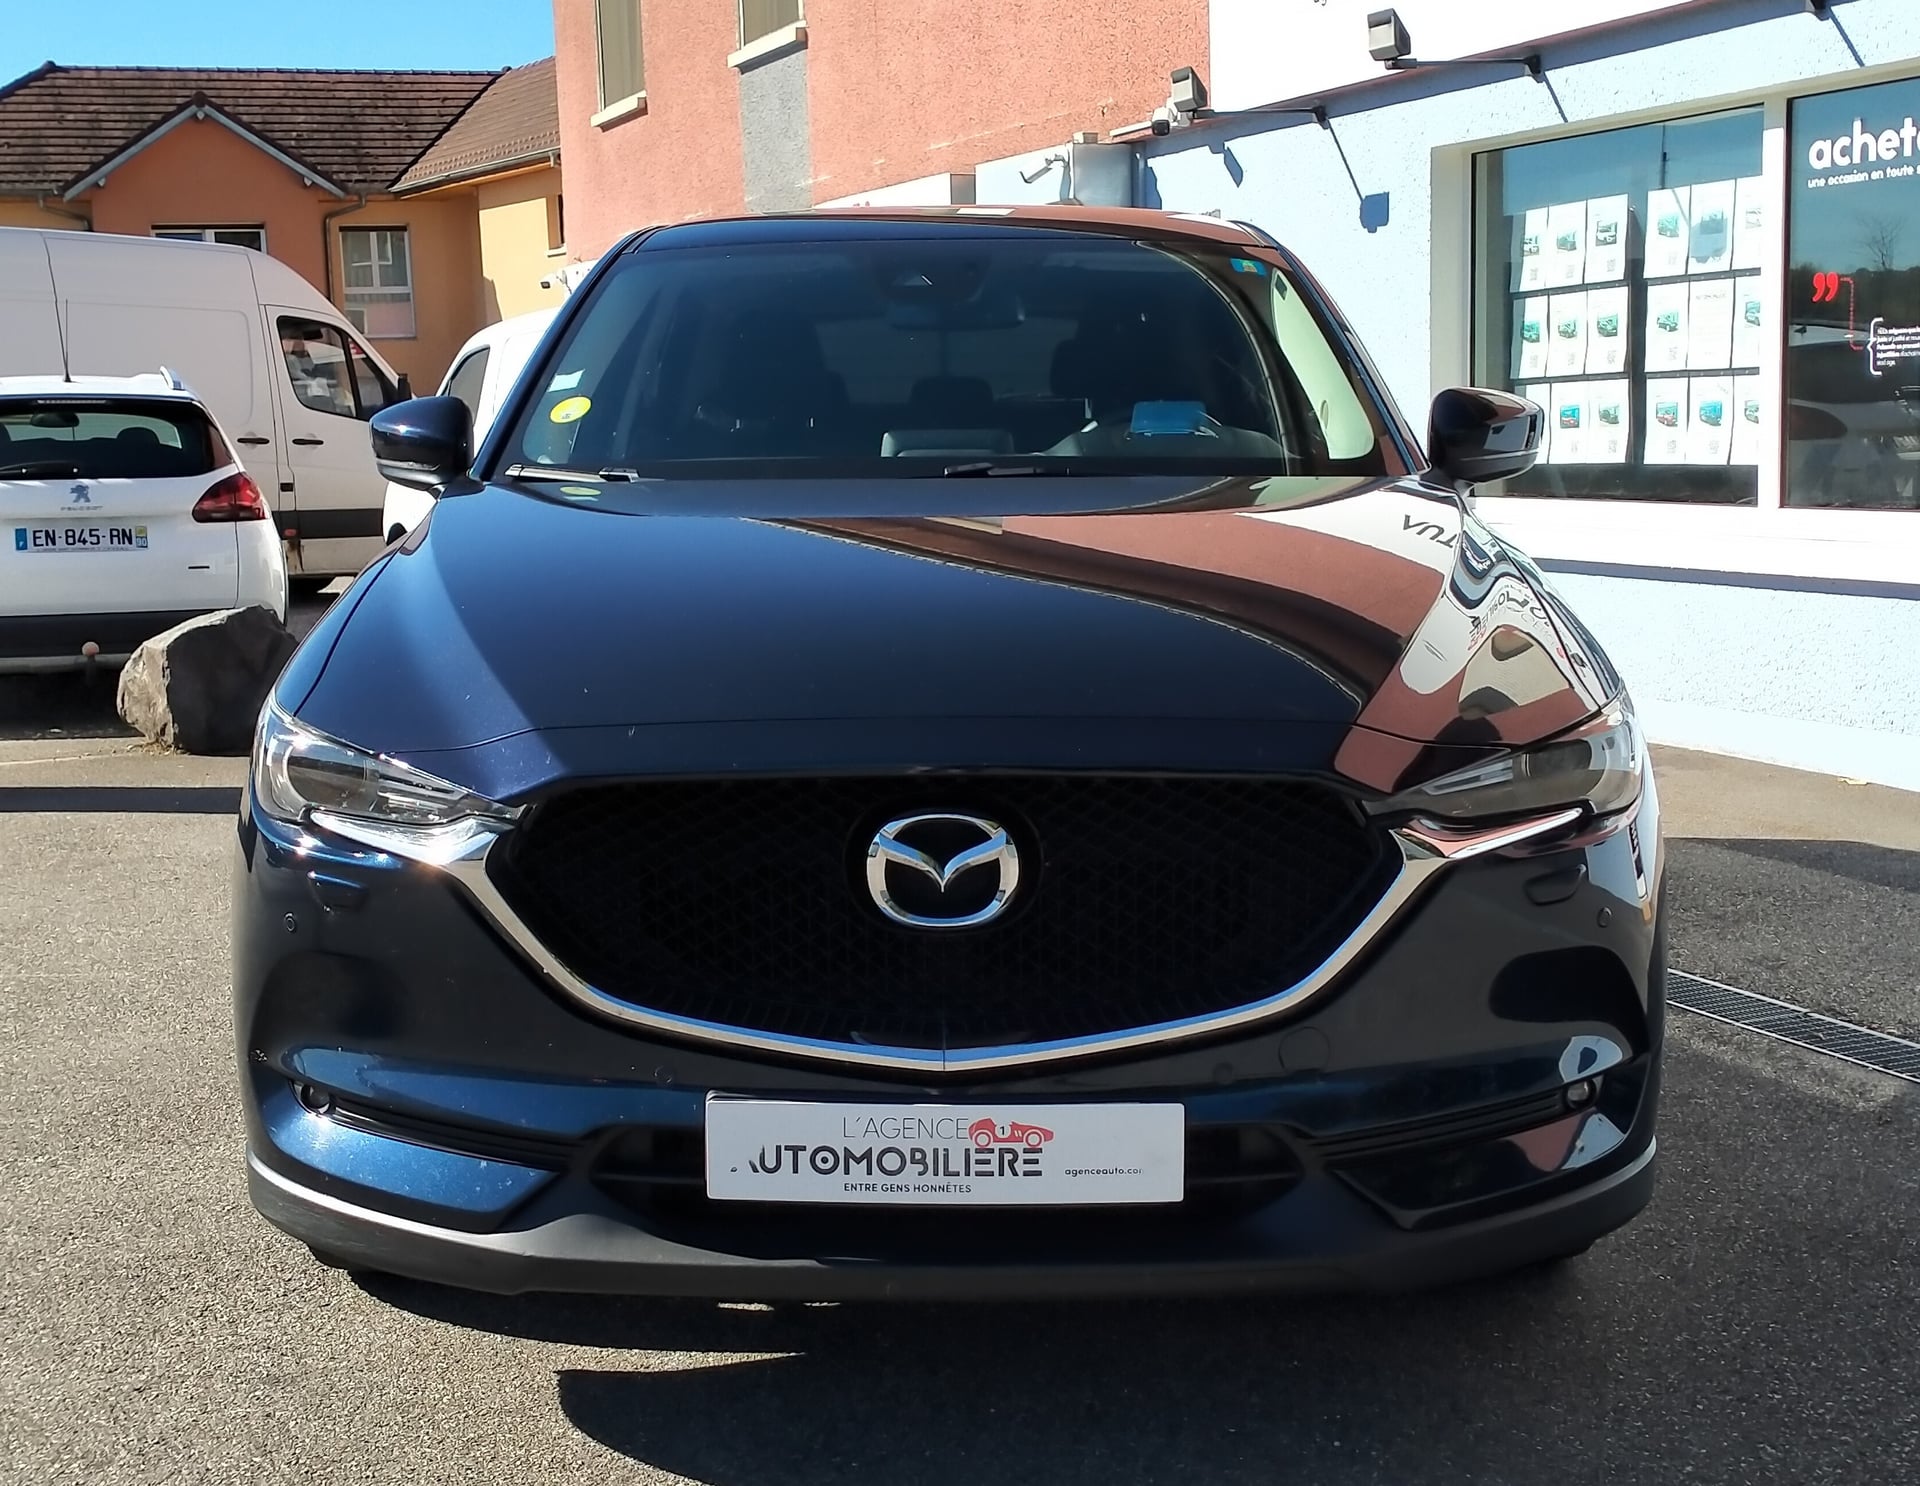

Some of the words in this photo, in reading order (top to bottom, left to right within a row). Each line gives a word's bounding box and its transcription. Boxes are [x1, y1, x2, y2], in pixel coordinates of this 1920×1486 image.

[1808, 117, 1920, 170] achet
[1807, 177, 1826, 188] une
[1828, 170, 1869, 186] occasion
[1871, 169, 1884, 180] en
[1886, 164, 1915, 178] toute
[32, 527, 133, 547] EN-845-RN
[844, 1183, 878, 1192] ENTRE
[880, 1183, 910, 1193] GENS
[913, 1181, 972, 1193] HONNÊTES
